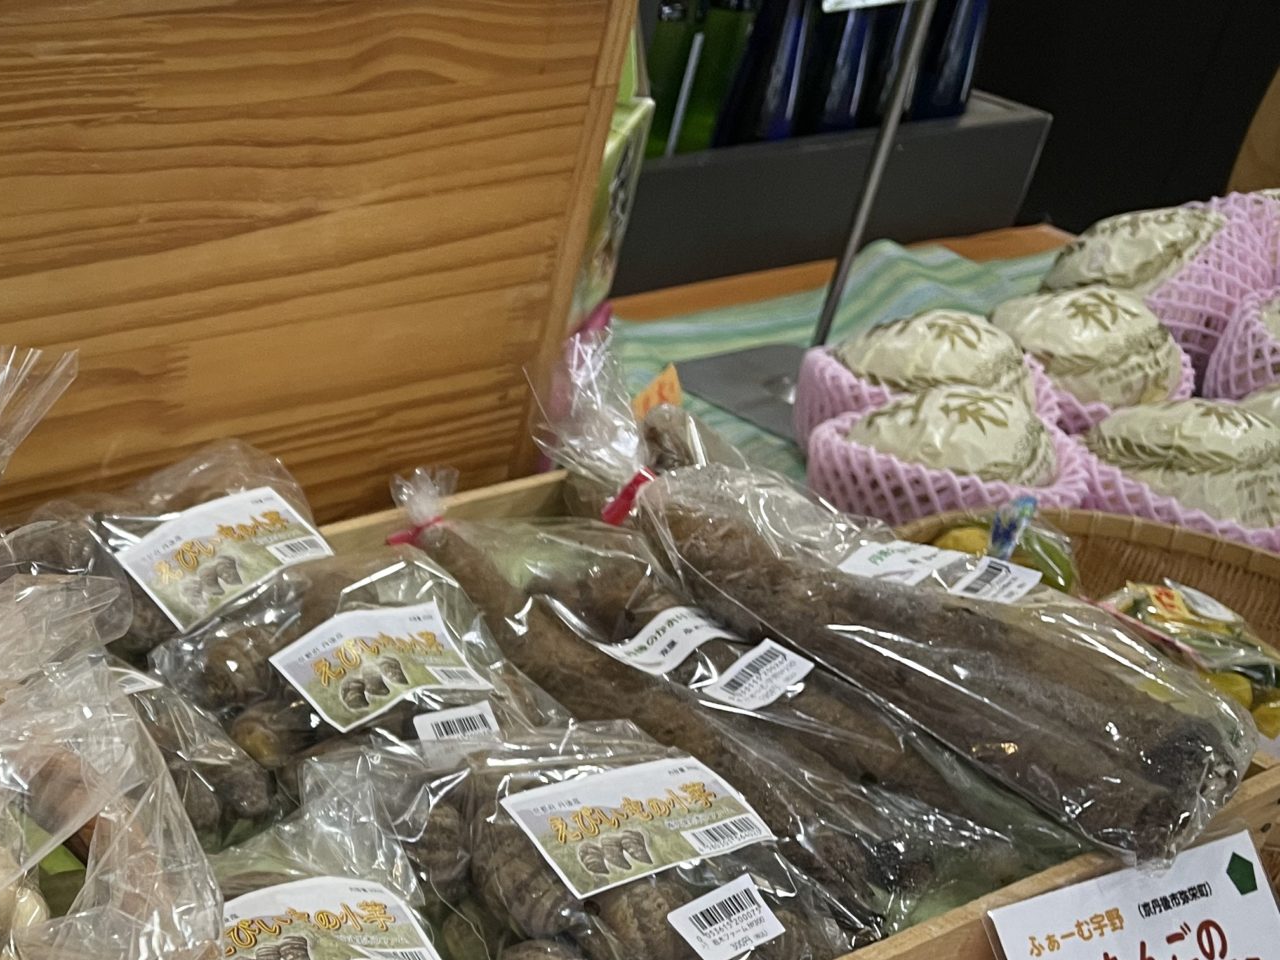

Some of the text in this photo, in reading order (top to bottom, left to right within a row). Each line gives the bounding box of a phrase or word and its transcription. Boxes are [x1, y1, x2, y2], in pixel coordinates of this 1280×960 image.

[1028, 907, 1125, 958] ふぁーむ宇野
